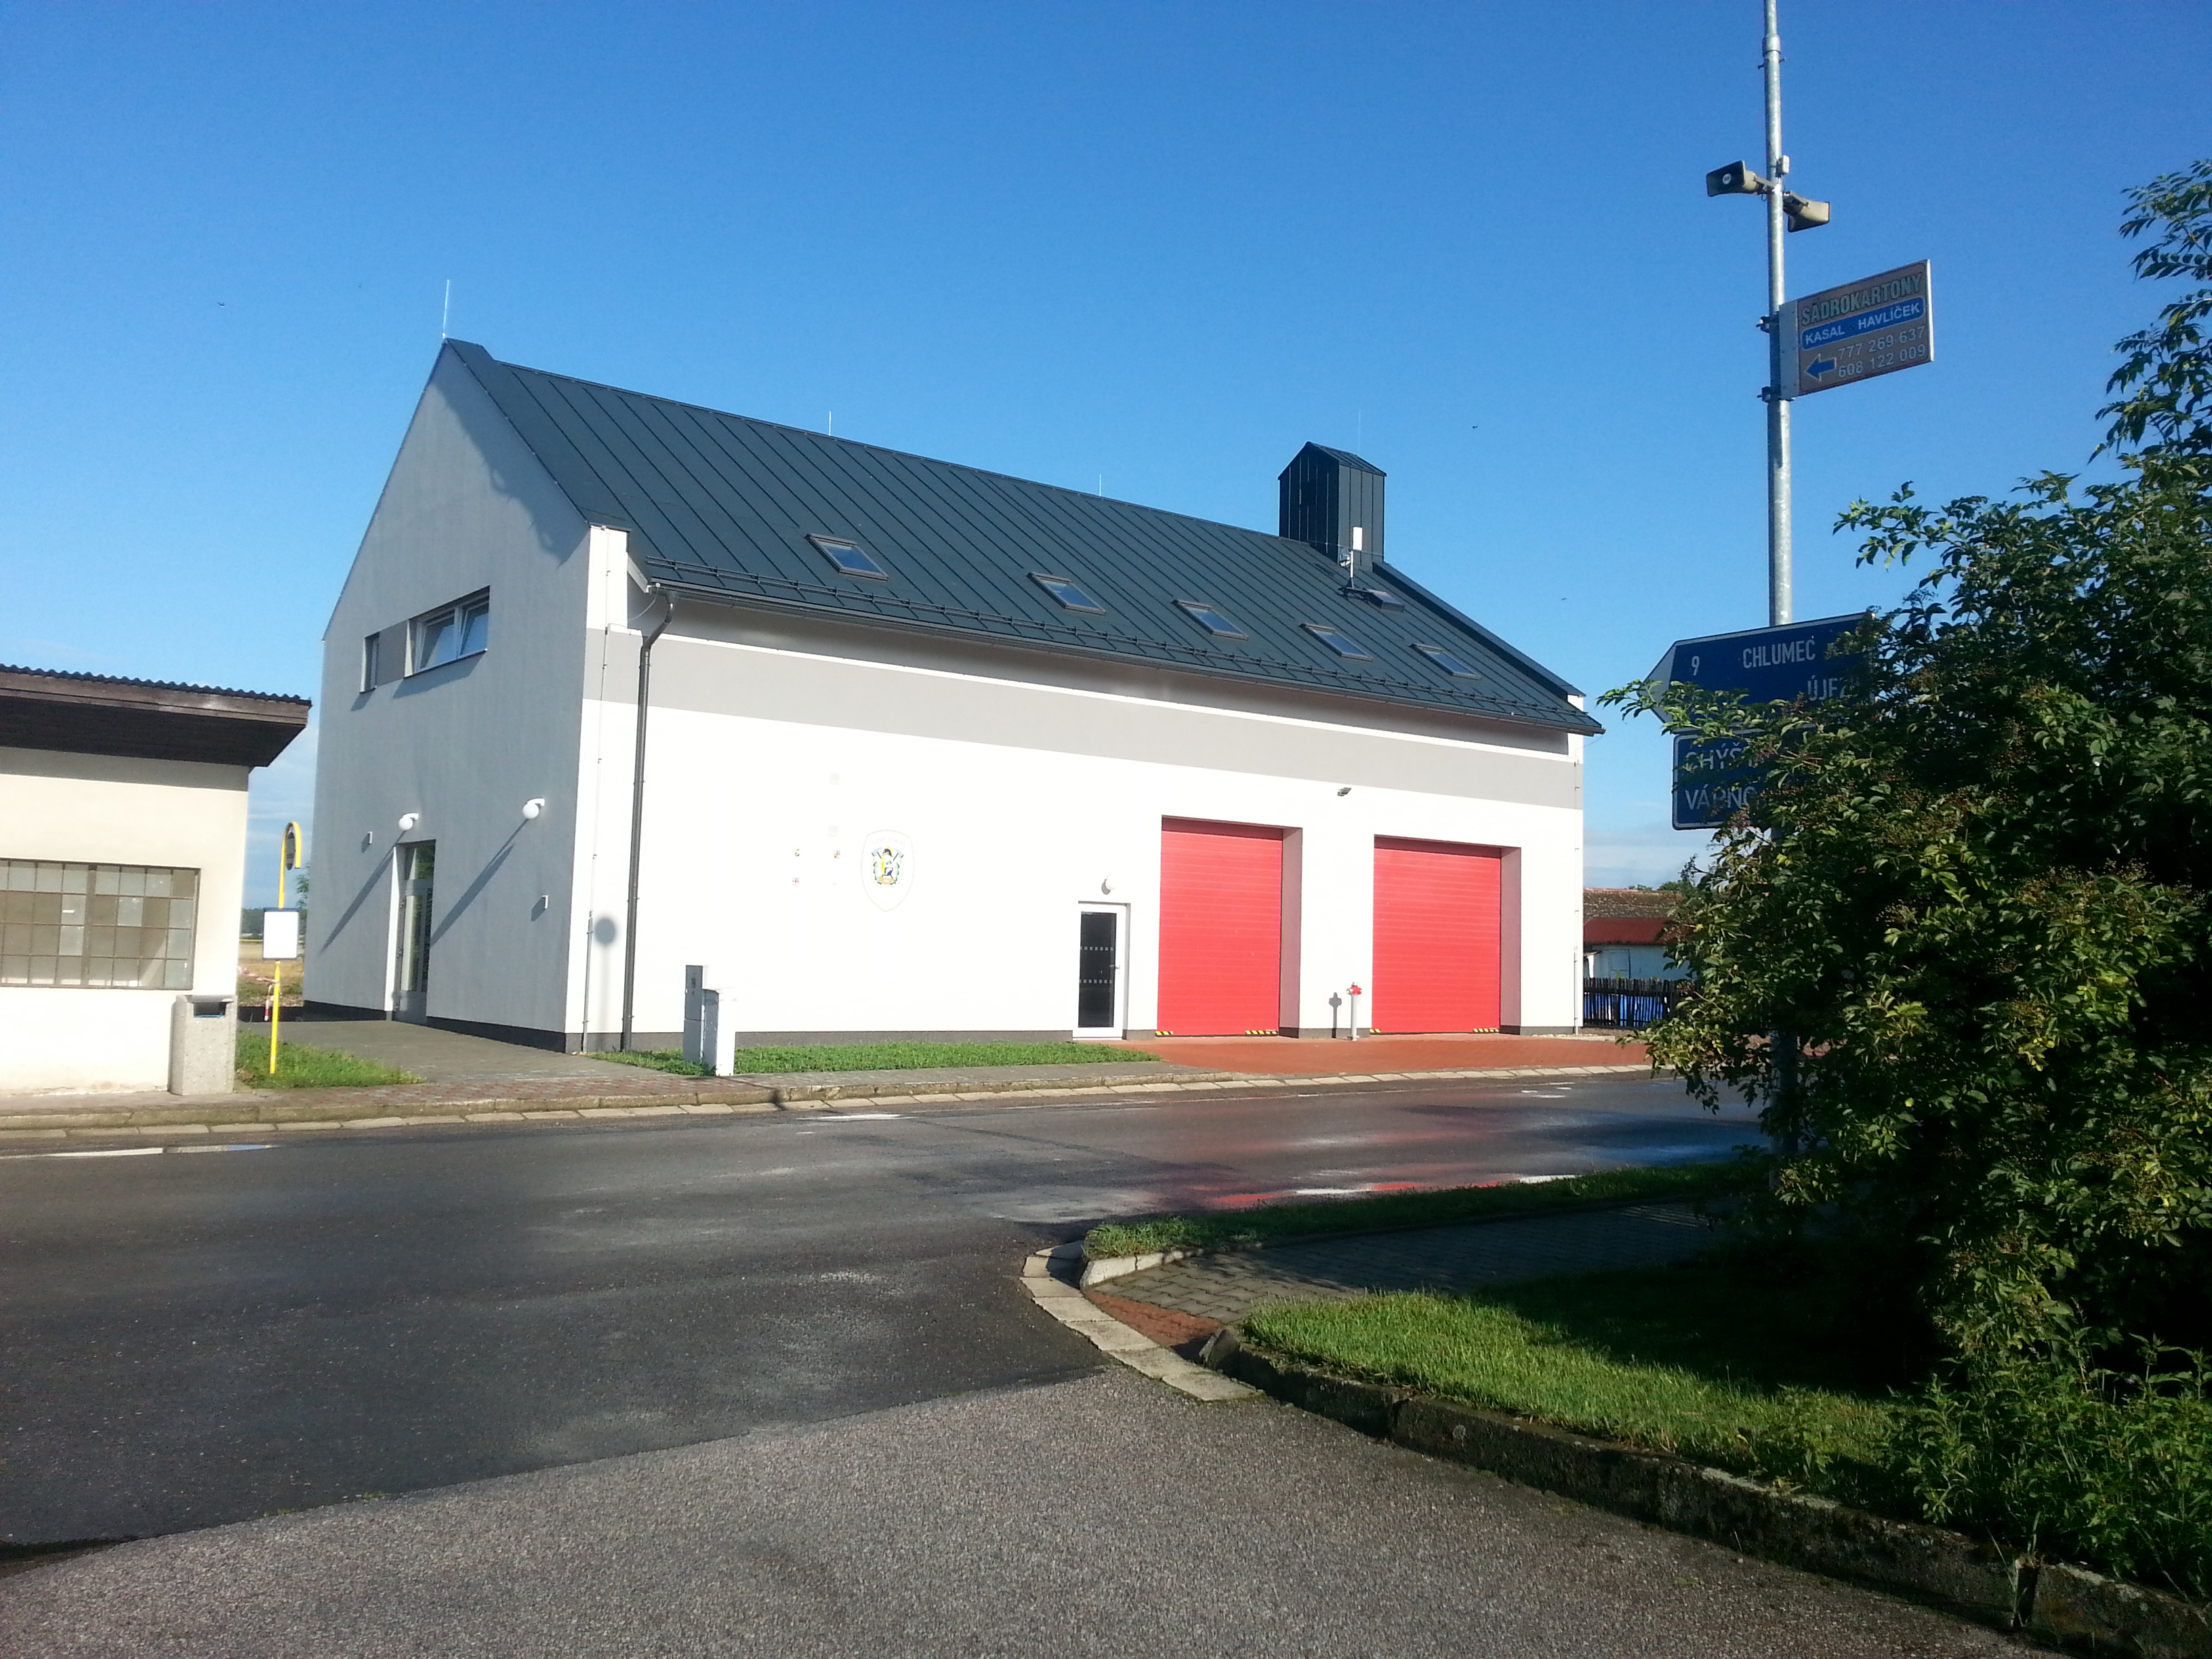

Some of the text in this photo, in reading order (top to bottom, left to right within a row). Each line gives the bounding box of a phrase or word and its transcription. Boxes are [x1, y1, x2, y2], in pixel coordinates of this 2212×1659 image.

[1801, 272, 1923, 327] SÁDROKARTONY
[1805, 327, 1845, 346] KASAL
[1858, 302, 1921, 330] HAVLÍČEK
[1838, 325, 1925, 360] 777 269 637
[1839, 345, 1926, 378] 608 122 009
[1691, 655, 1700, 676] 9
[1742, 638, 1816, 669] CHLUMEC
[1807, 674, 1860, 701] ÚJEZ
